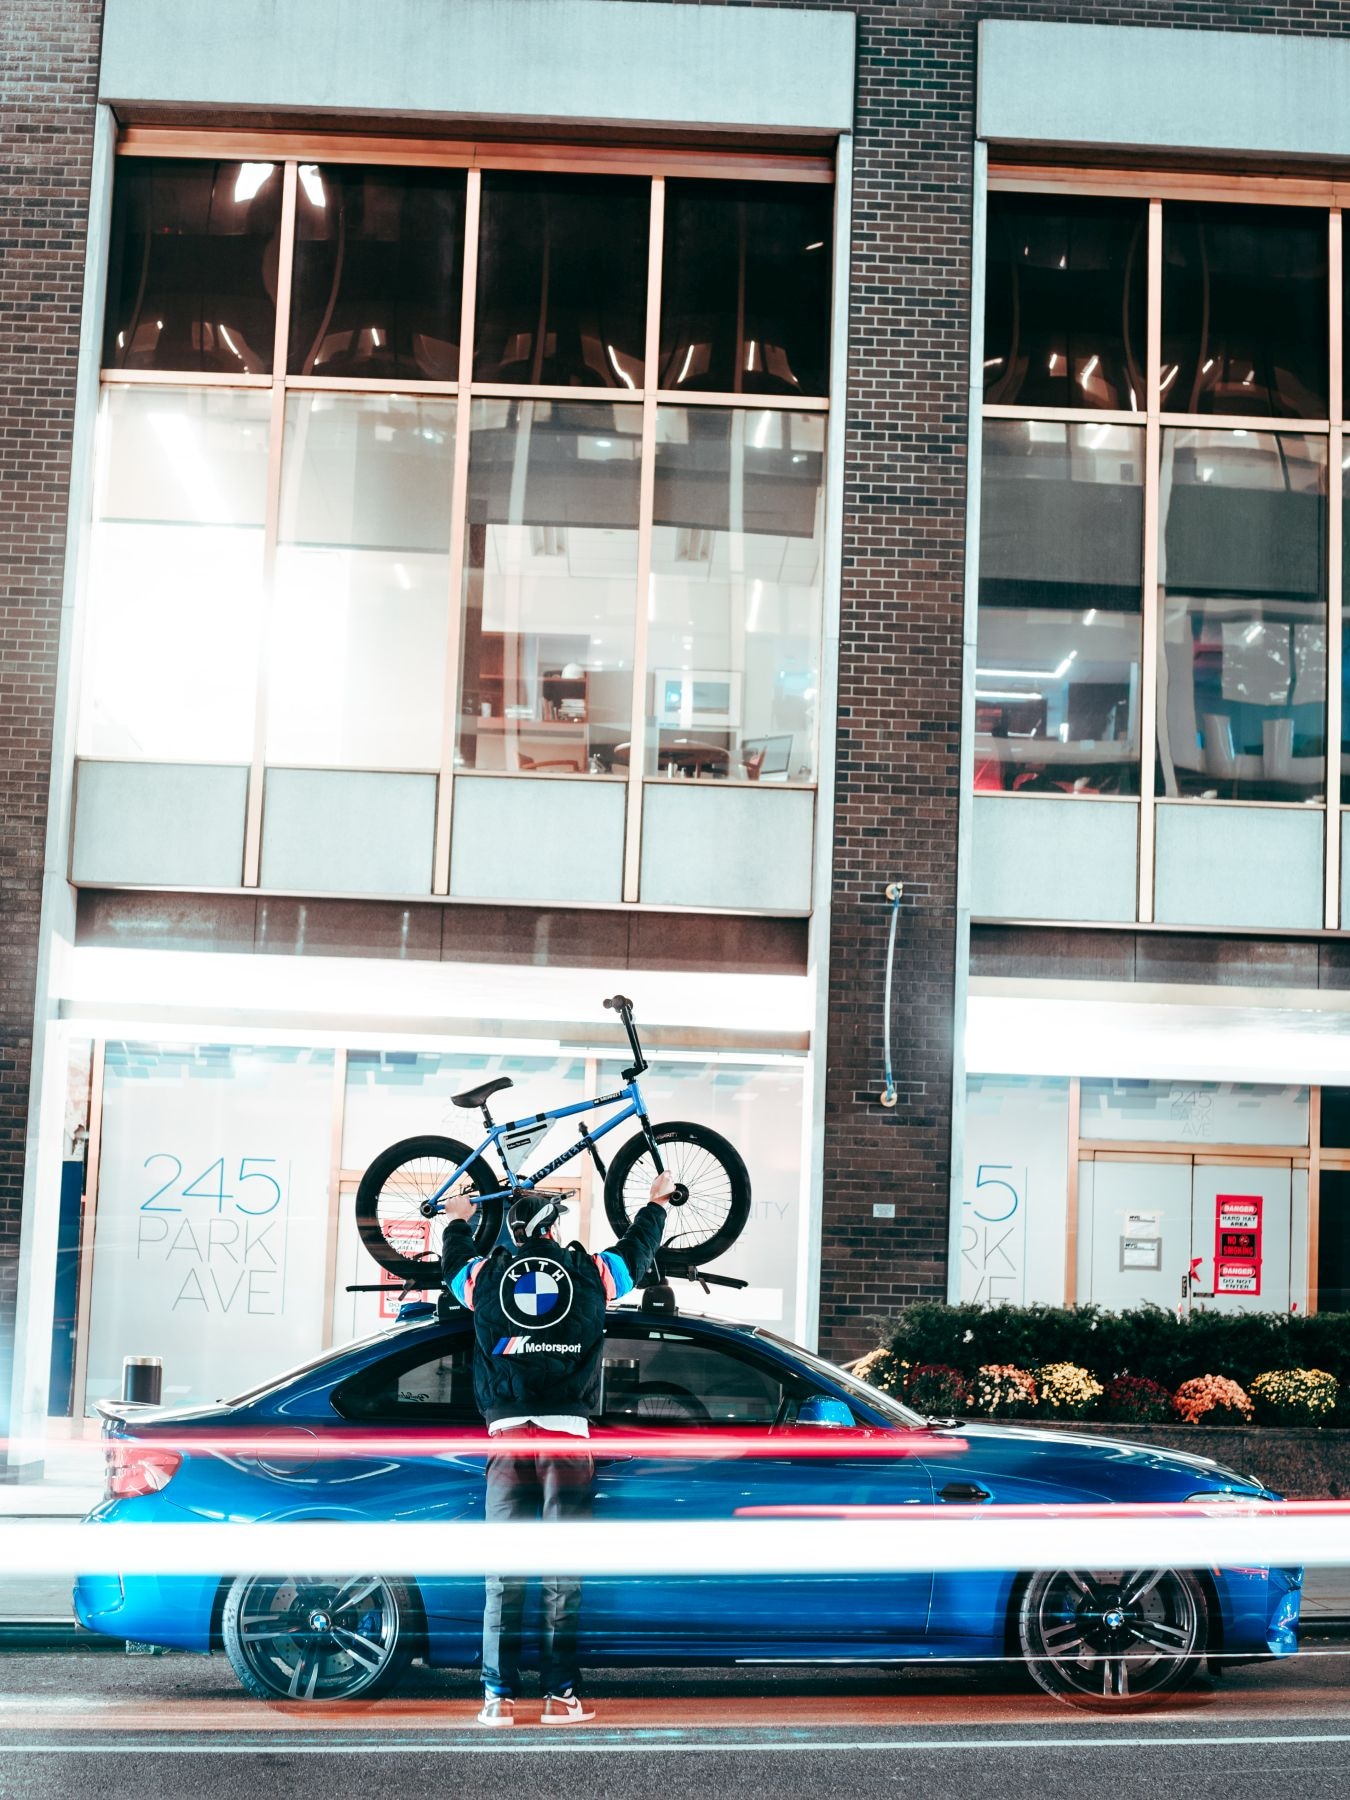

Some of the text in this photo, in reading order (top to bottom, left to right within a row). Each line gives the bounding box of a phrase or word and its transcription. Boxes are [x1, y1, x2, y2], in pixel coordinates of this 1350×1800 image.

[1171, 1088, 1212, 1108] 245
[1180, 1121, 1211, 1137] AVE
[140, 1154, 280, 1215] 245
[962, 1165, 1018, 1222] 5
[1223, 1205, 1255, 1213] DANGER
[137, 1215, 277, 1264] PARK
[1227, 1236, 1237, 1245] NO
[1223, 1246, 1254, 1256] SMOKING
[508, 1261, 564, 1282] KITH
[1222, 1267, 1253, 1275] DANGER
[171, 1268, 277, 1315] AVE
[525, 1342, 581, 1354] Motorsport
